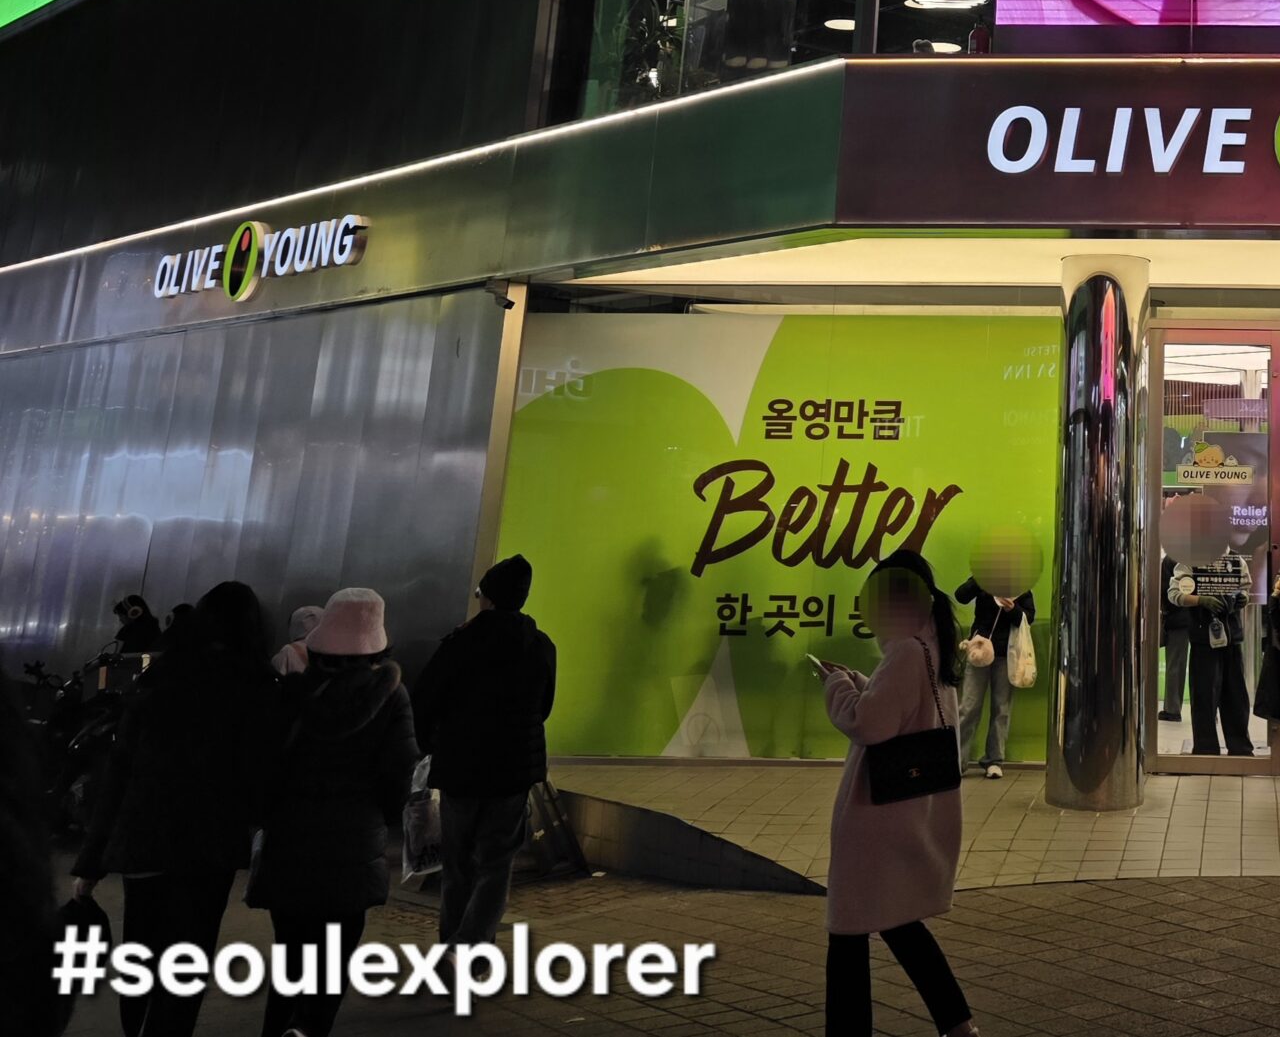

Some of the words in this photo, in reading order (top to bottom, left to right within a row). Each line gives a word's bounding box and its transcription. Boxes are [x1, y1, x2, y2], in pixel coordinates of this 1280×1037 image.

[987, 105, 1252, 175] OLIVE
[154, 243, 225, 298] OLIVE
[260, 214, 371, 279] YOUNG
[762, 398, 905, 441] 올영만큼
[1183, 470, 1211, 479] OLIVE
[1214, 471, 1248, 480] YOUNG
[690, 458, 964, 578] Better
[716, 593, 753, 637] 한
[763, 595, 837, 638] 곳의
